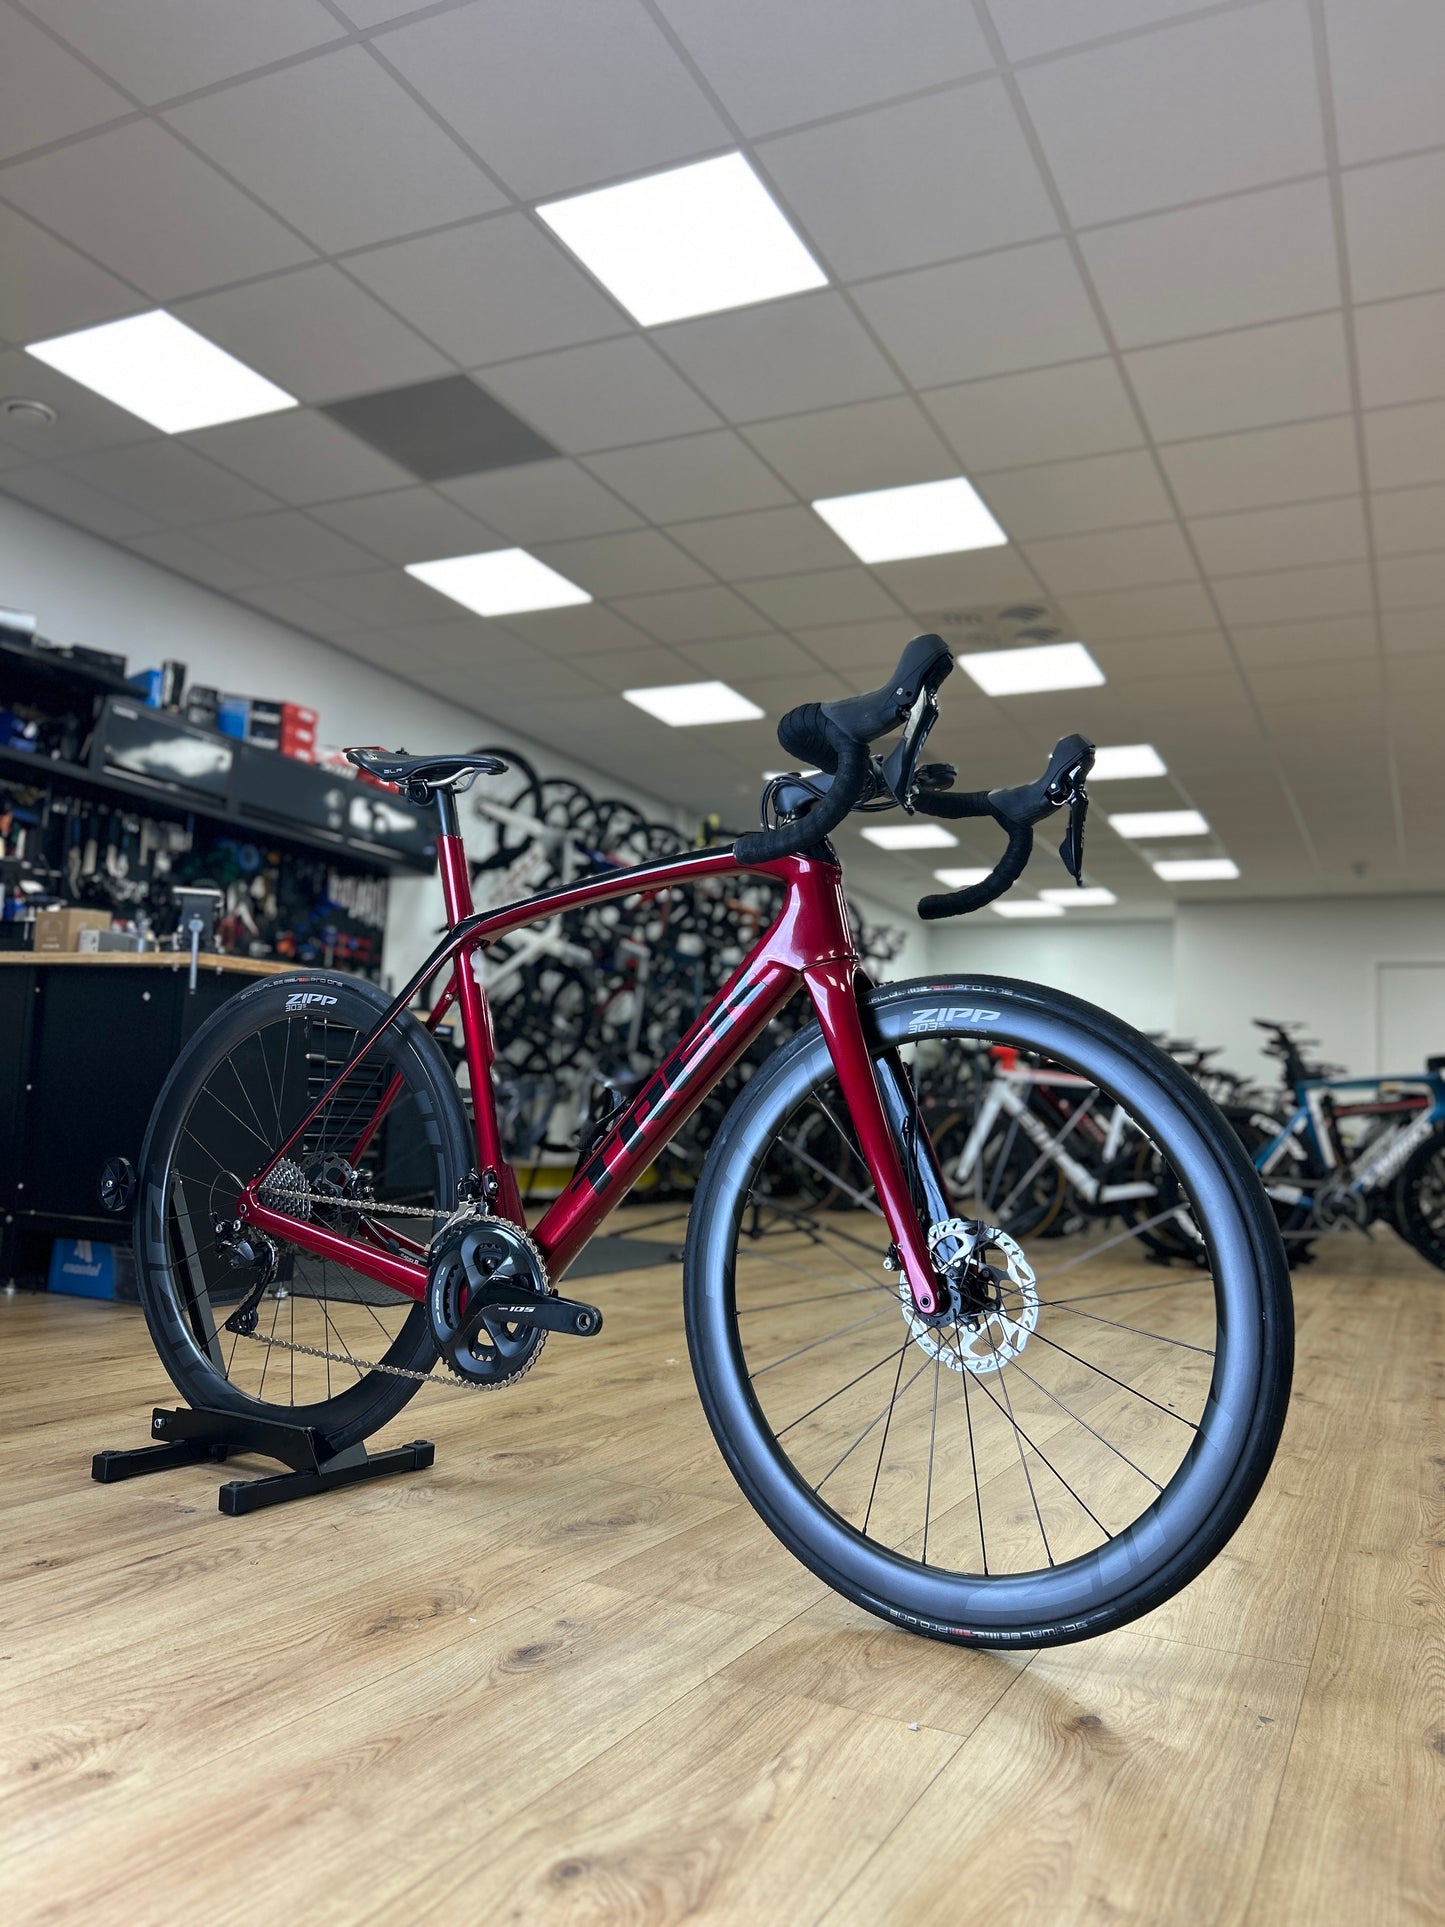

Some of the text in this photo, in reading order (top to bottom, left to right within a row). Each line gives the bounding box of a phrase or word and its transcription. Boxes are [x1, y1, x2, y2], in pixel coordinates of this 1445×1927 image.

[286, 993, 338, 1005] ZIPP
[909, 1008, 1000, 1024] ZIPP
[571, 958, 767, 1195] TREK
[1001, 1619, 1088, 1641] SCHWALBE
